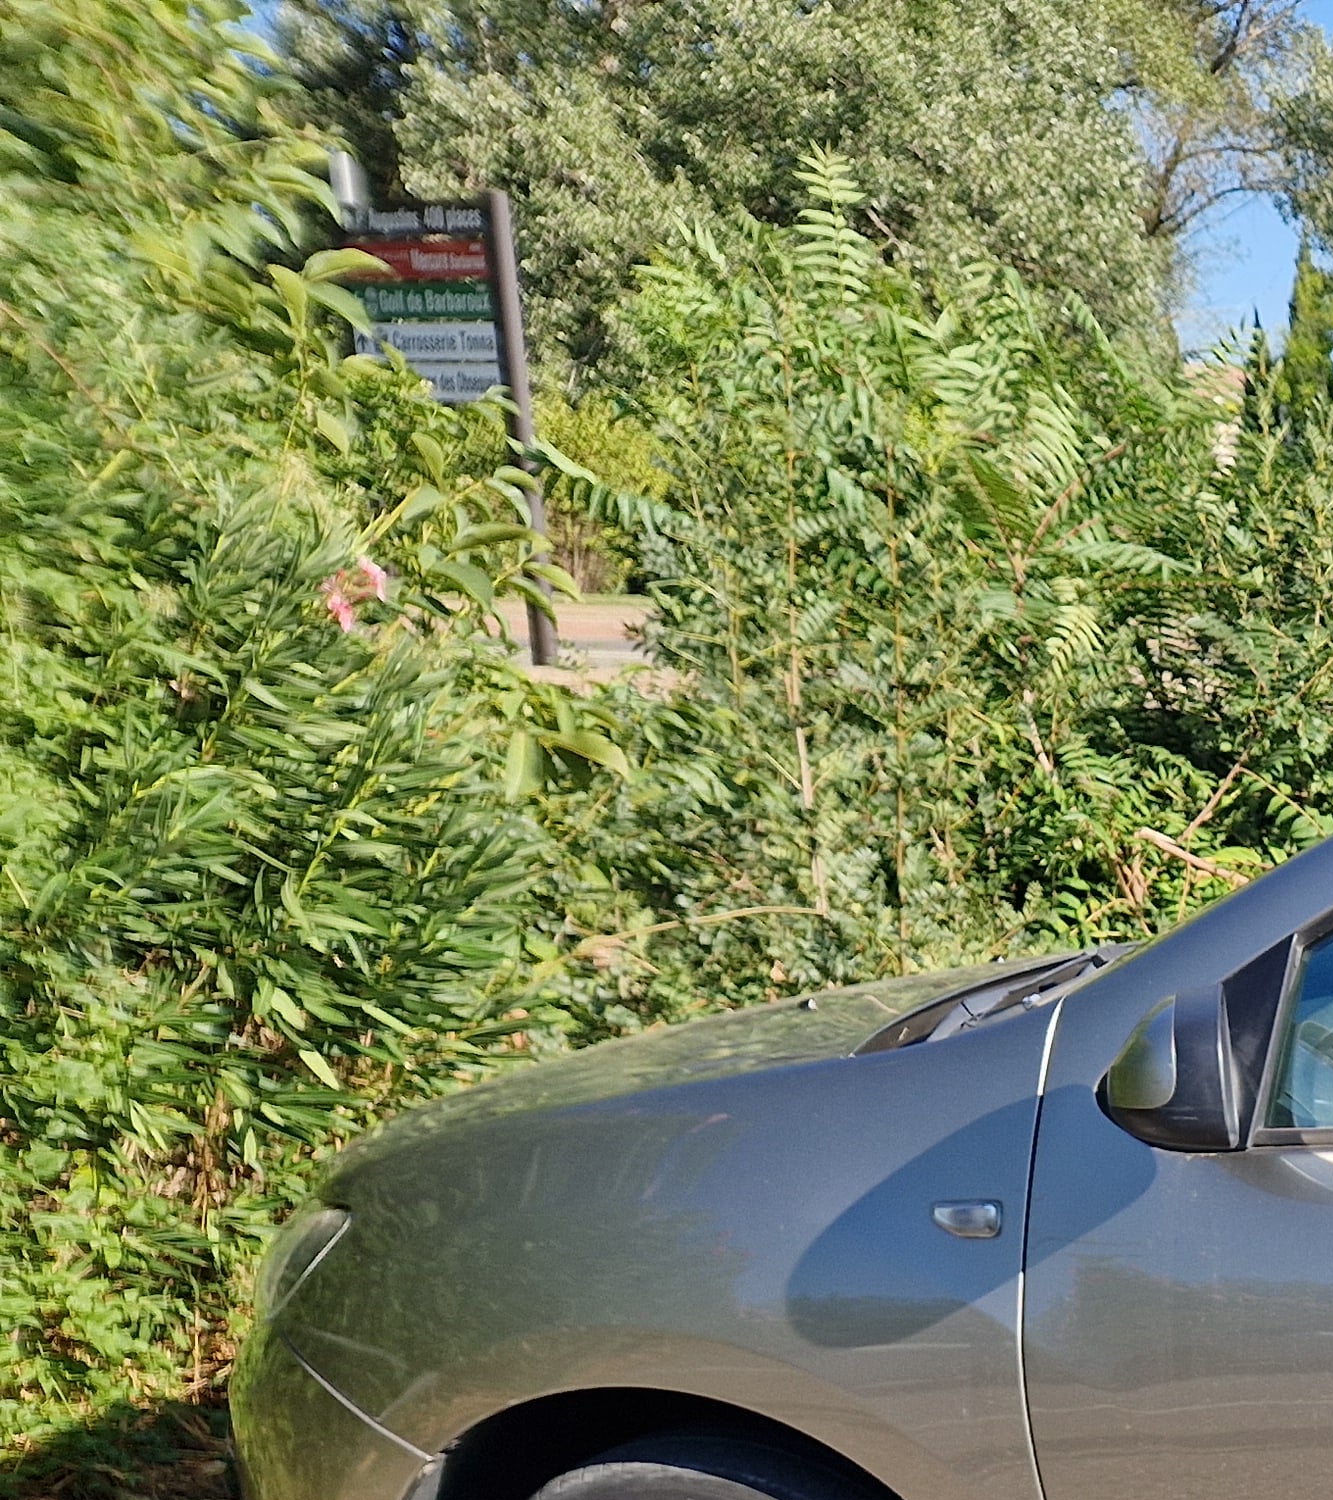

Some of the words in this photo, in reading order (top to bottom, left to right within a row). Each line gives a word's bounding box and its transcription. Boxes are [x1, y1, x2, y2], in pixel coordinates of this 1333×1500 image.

[379, 289, 403, 312] Golf
[407, 290, 422, 312] de
[424, 288, 490, 313] Barbaroux
[393, 330, 457, 352] Carrosserie
